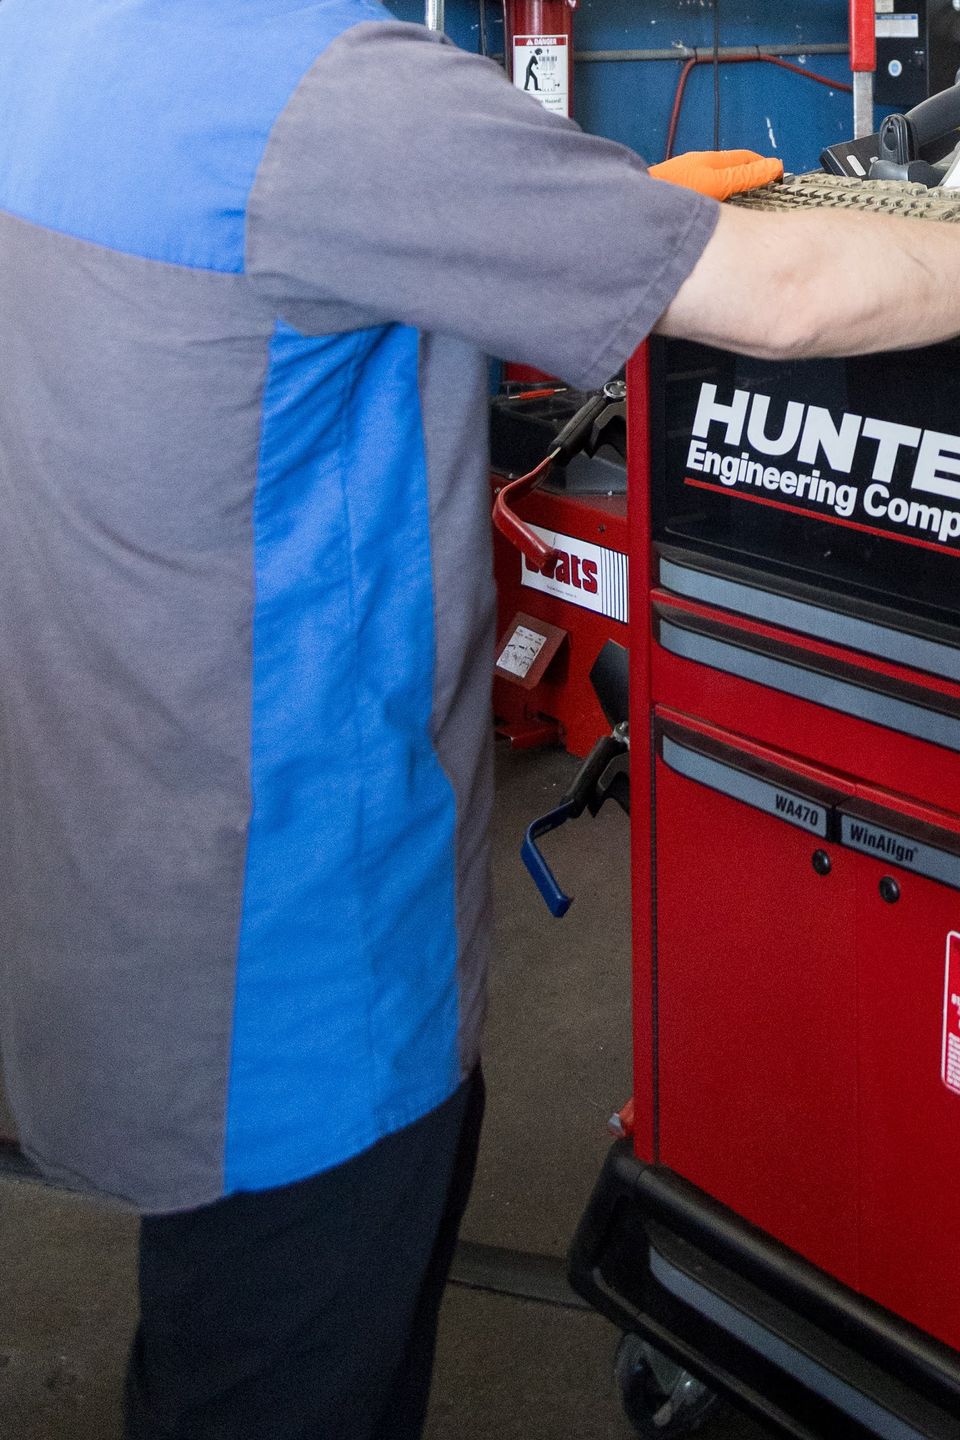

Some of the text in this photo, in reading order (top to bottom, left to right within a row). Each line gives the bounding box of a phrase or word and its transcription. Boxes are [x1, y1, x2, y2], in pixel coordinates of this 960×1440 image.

[686, 440, 858, 517] Engineering
[775, 793, 916, 863] WA470 WinAlign
